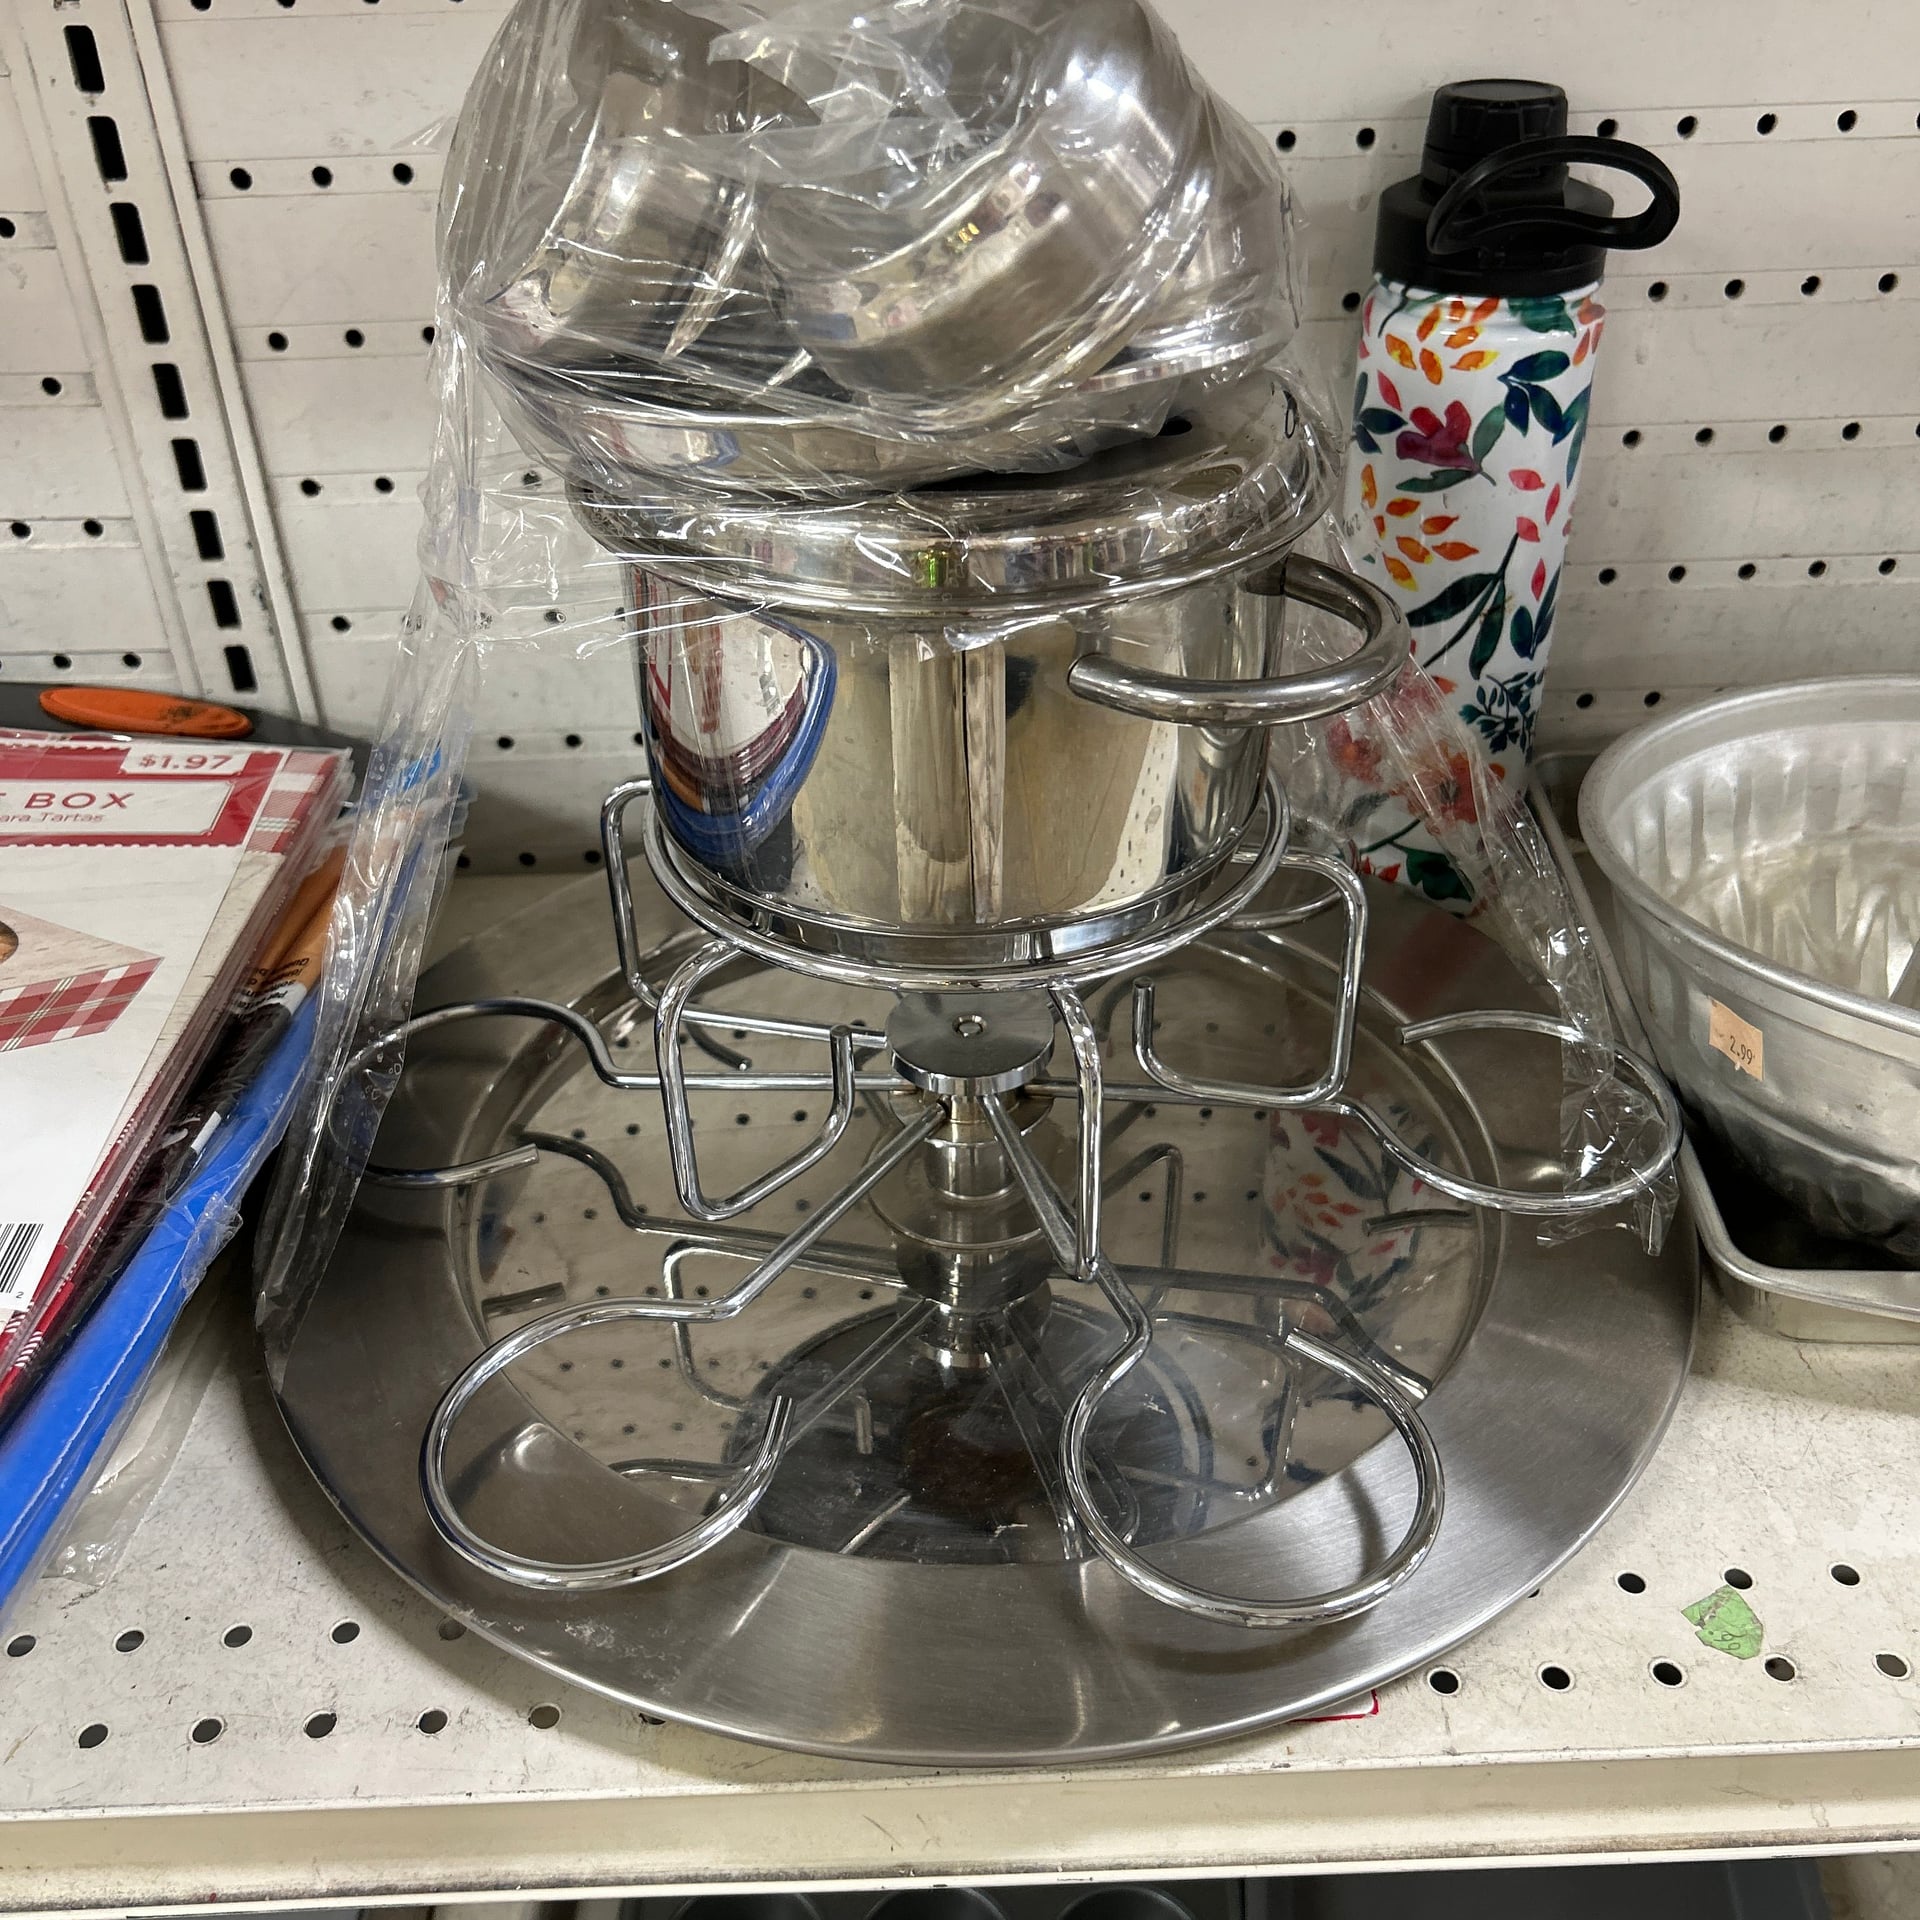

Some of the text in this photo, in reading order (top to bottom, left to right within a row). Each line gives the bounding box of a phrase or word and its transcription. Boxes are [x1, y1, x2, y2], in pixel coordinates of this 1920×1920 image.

[139, 754, 233, 769] $1.97
[24, 792, 135, 809] BOX
[40, 812, 105, 823] Tartas
[1729, 1034, 1754, 1065] 2.99
[16, 1291, 24, 1299] 2
